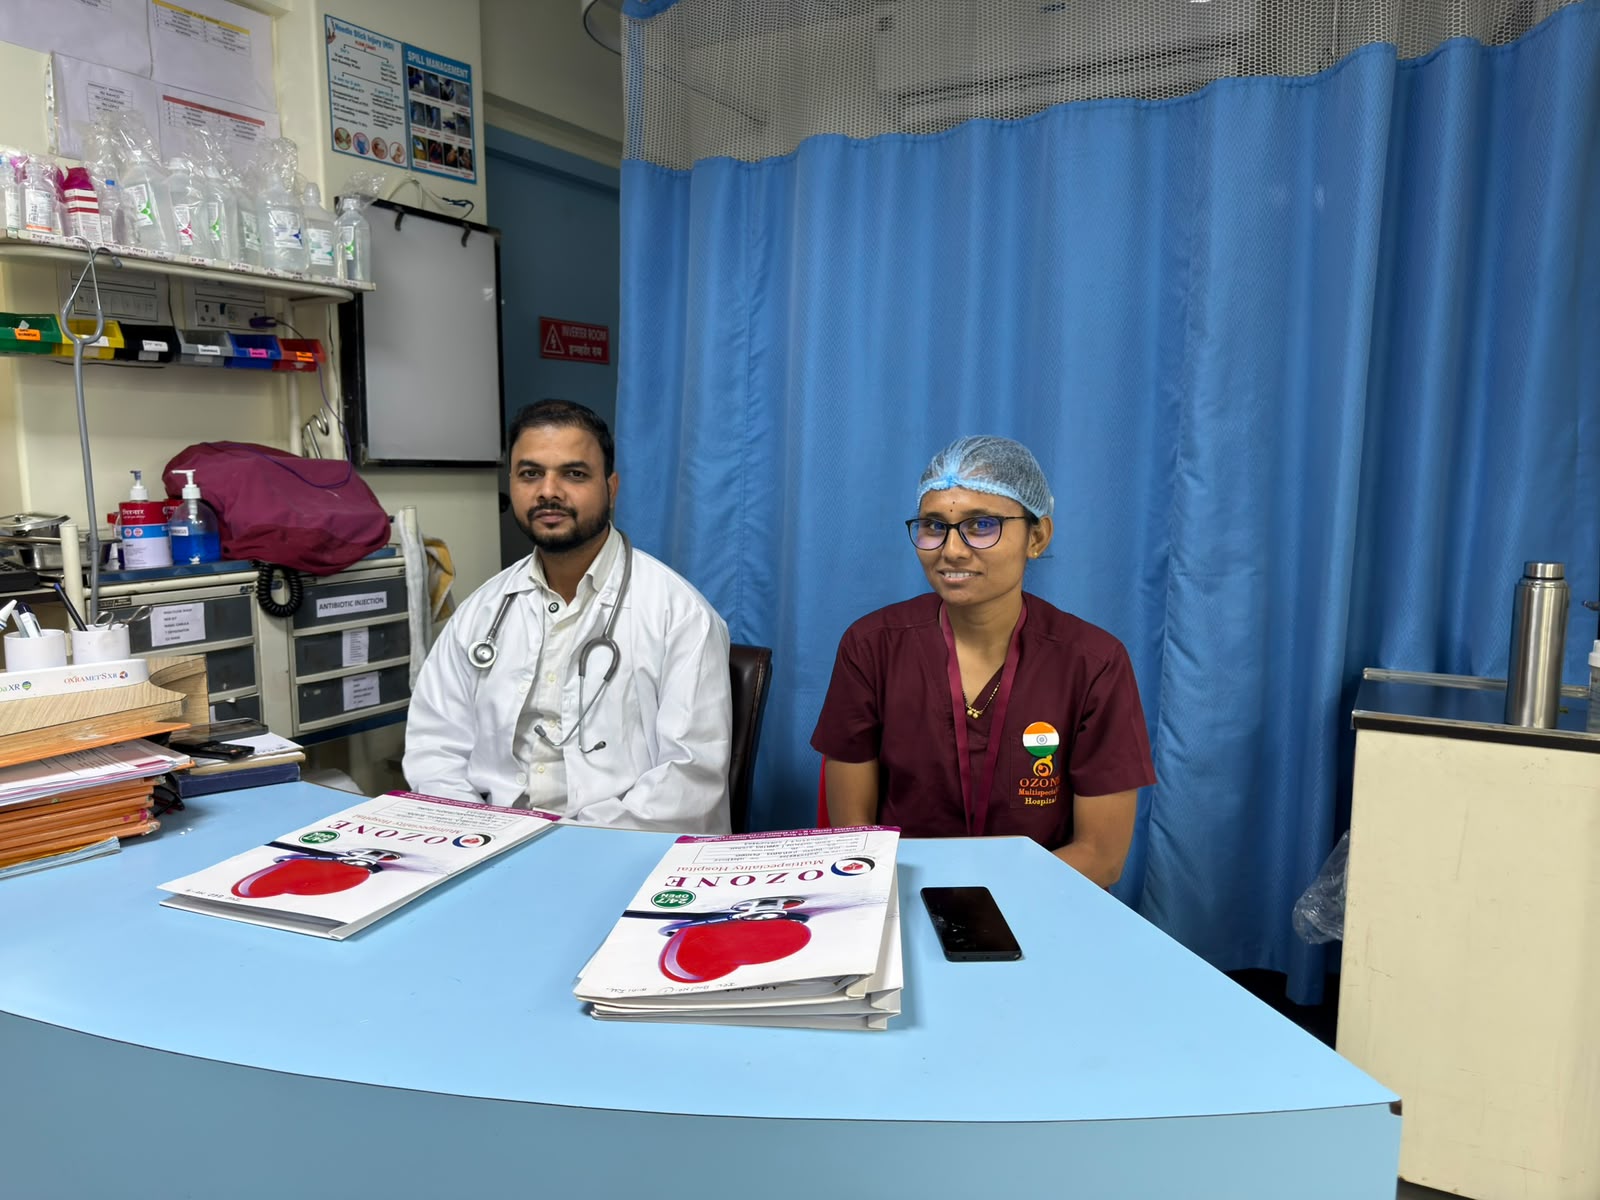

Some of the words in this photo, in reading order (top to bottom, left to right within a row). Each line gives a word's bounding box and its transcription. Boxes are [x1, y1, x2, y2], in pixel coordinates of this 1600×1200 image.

[335, 23, 353, 36] Needle
[354, 29, 366, 40] Stick
[367, 32, 382, 47] Injury
[407, 51, 425, 66] SPILL
[426, 57, 469, 79] MANAGEMENT
[588, 328, 607, 341] ROOM
[319, 601, 354, 610] ANTIBIOTIC
[354, 597, 385, 606] INJECTION
[352, 813, 397, 827] Hospital
[327, 820, 448, 845] OZONE
[398, 822, 462, 835] Multispeciality
[676, 864, 728, 873] Hospital
[732, 858, 825, 873] Multispeciality
[664, 869, 824, 888] OZONE
